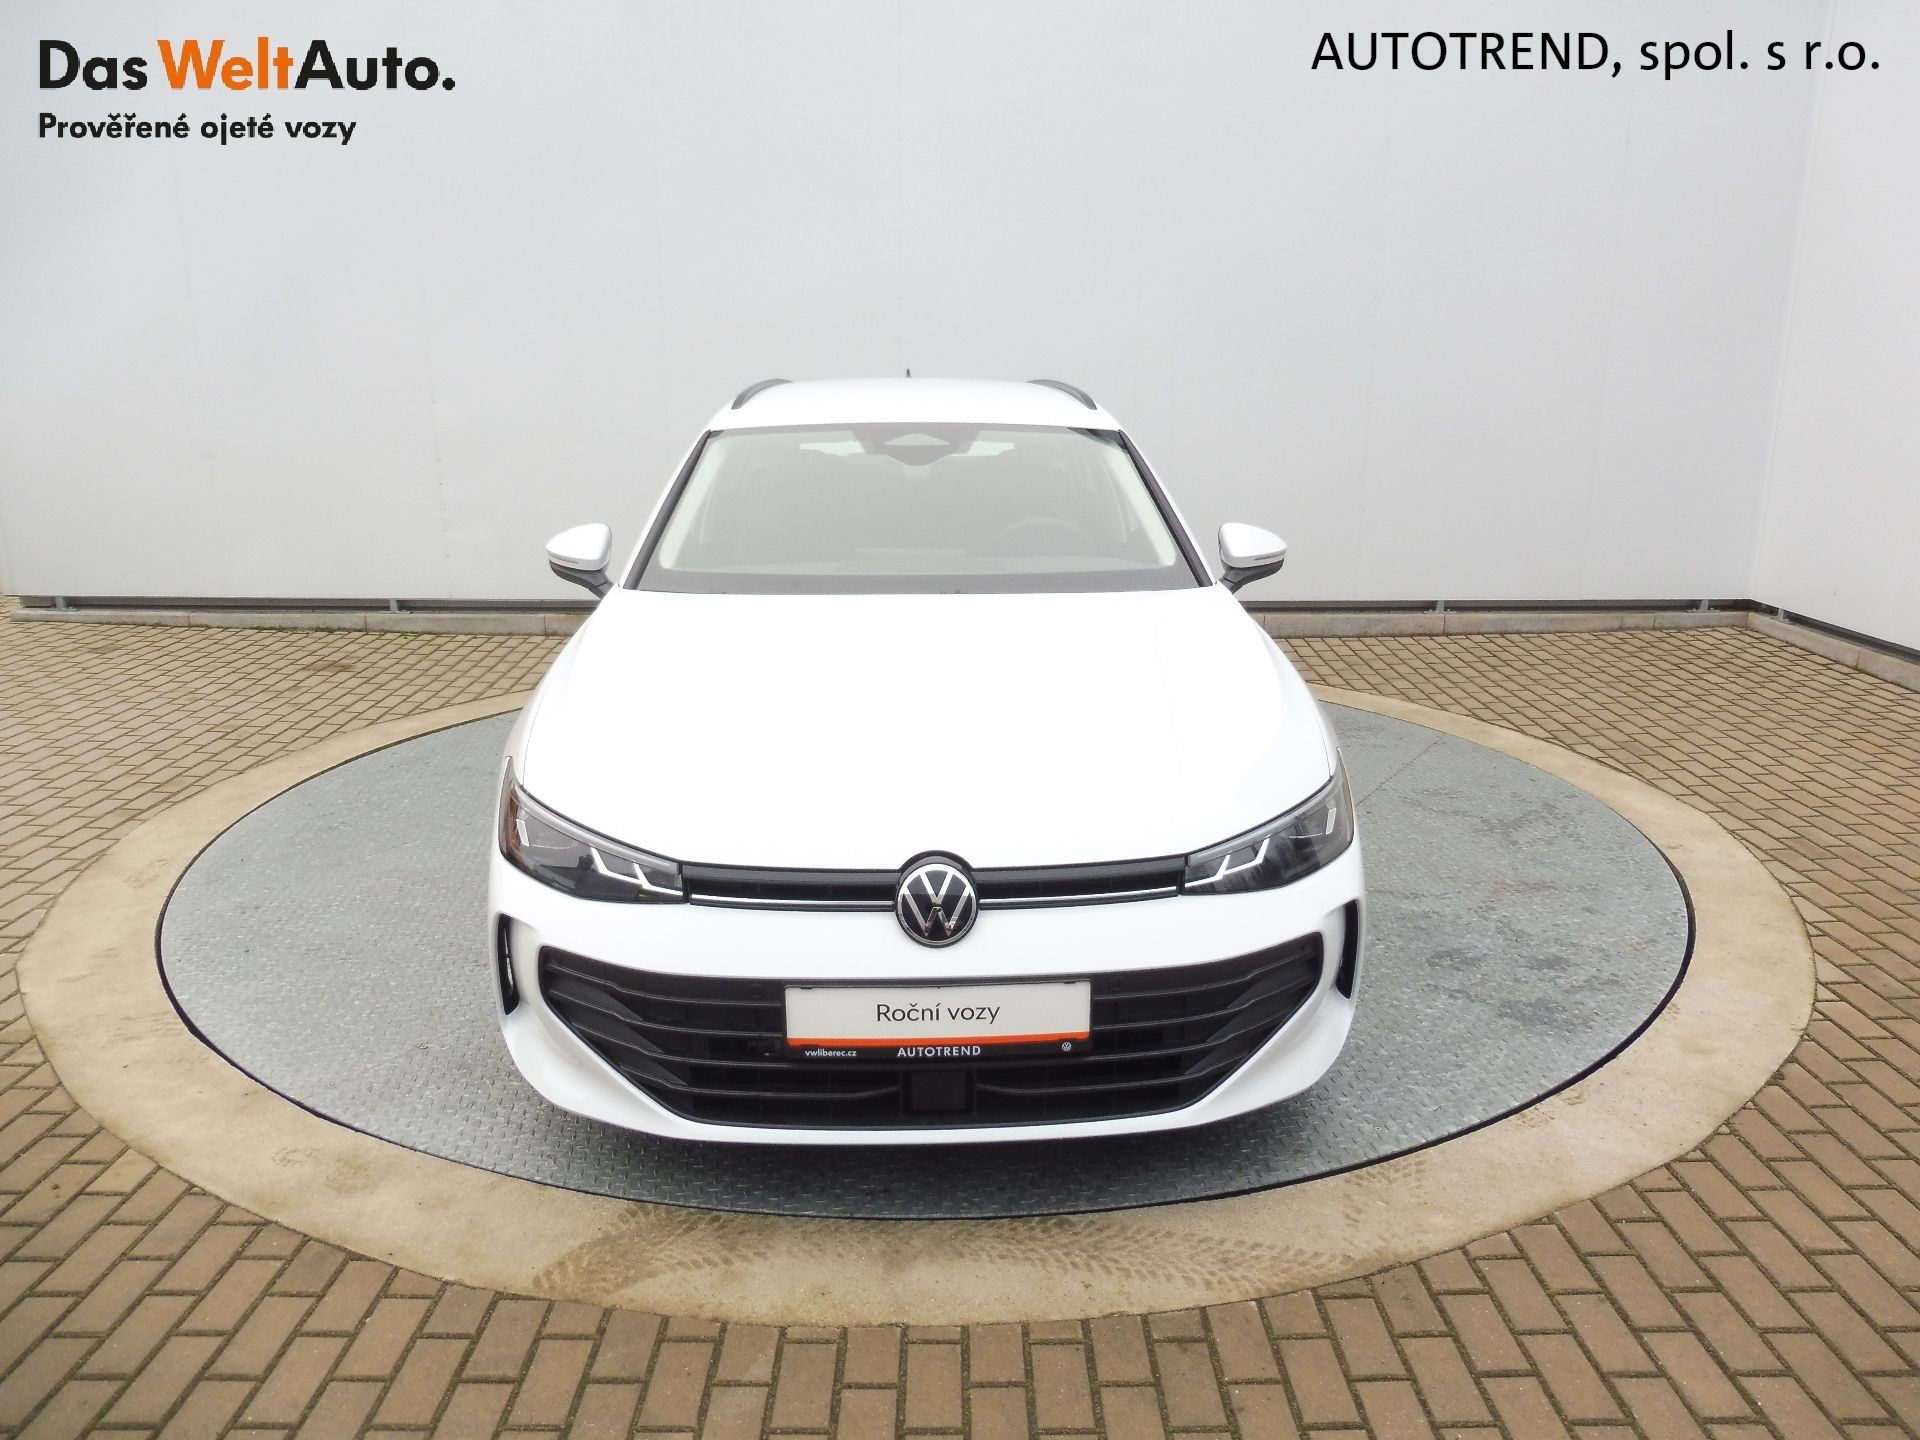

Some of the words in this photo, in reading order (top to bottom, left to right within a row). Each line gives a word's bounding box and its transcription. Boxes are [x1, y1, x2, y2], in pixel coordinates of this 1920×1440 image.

[876, 1003, 941, 1022] Roční
[946, 1006, 1001, 1025] vozy
[804, 1048, 858, 1058] vwliberec.cz
[896, 1045, 982, 1058] AUTOTREND
